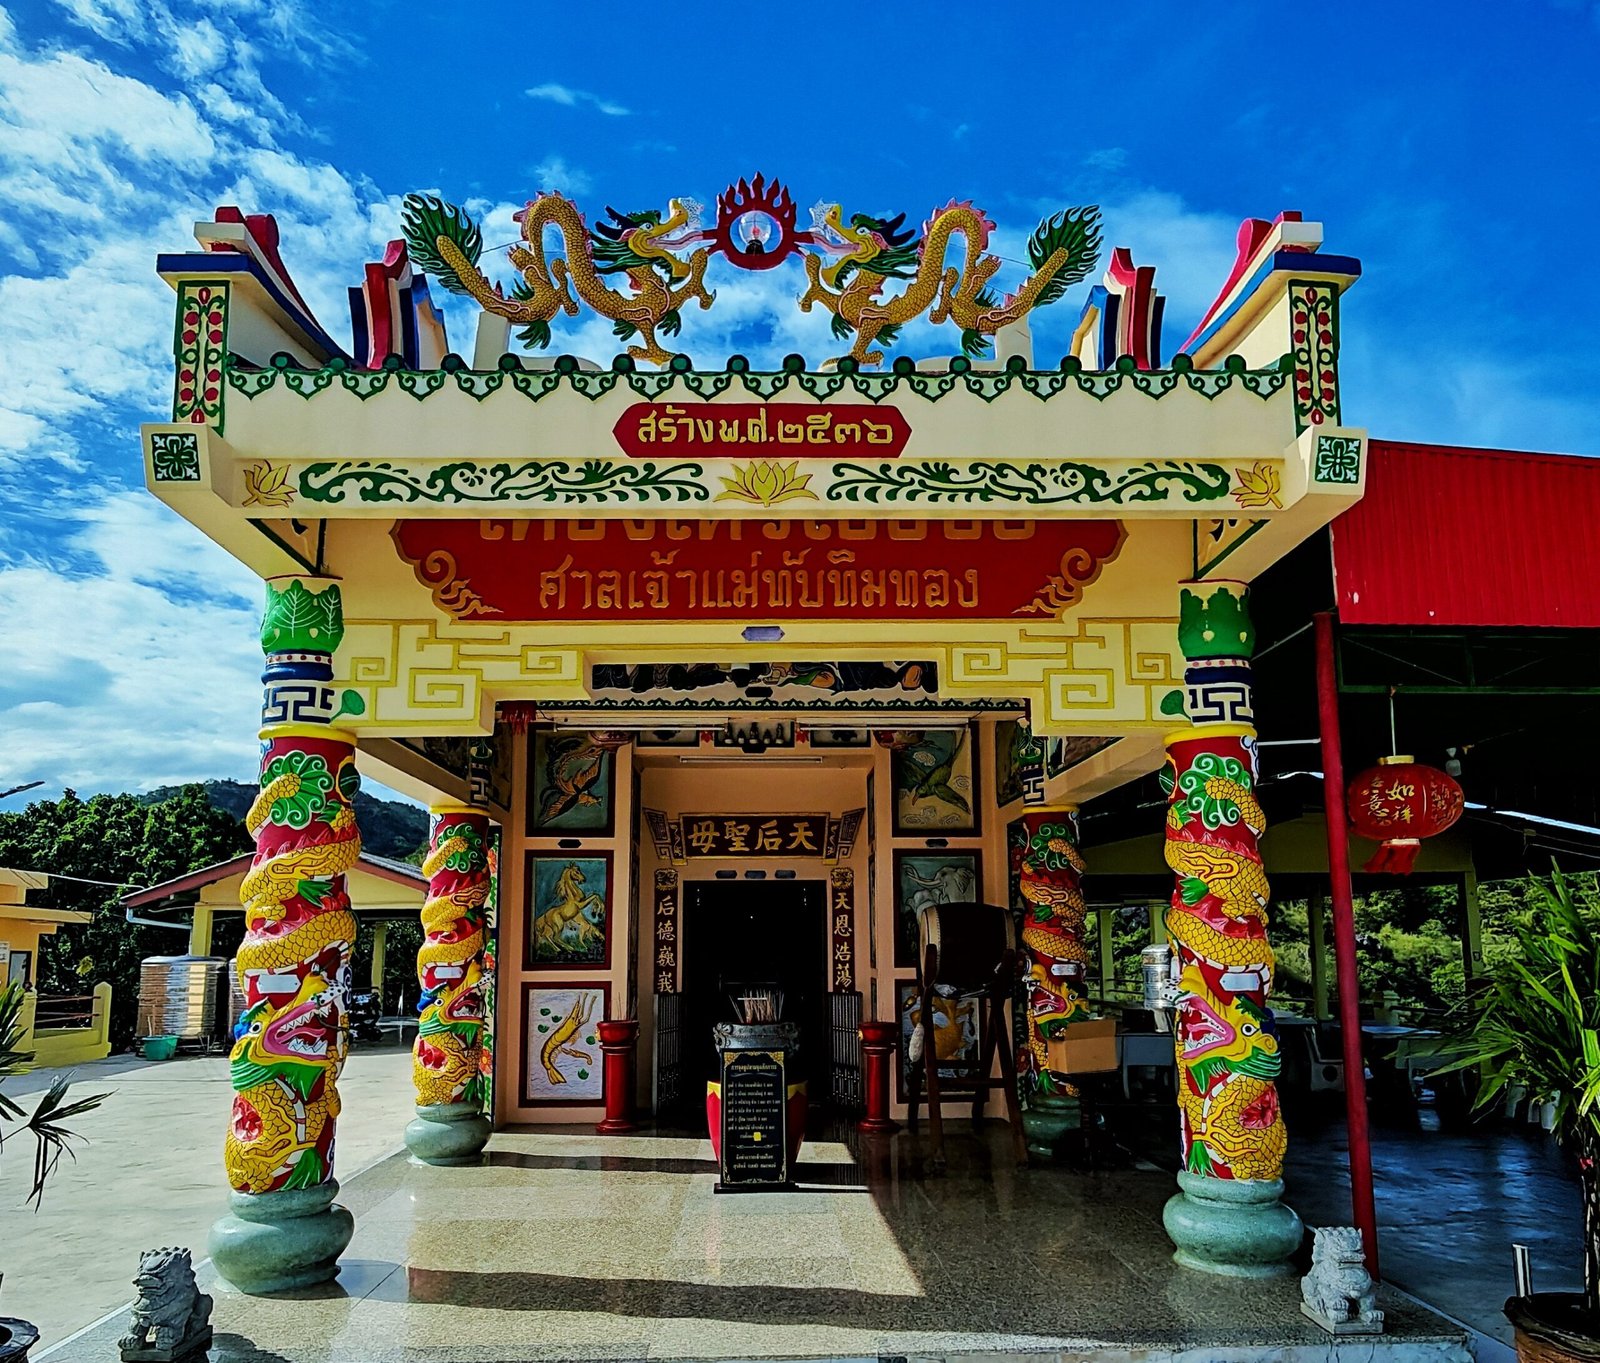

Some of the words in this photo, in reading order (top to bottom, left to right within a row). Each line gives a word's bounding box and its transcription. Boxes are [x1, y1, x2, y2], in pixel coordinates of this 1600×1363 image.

[539, 547, 979, 609] ศาลเจ้าแม่ทับทิมทอง
[834, 892, 853, 994] 天恩浩蕩
